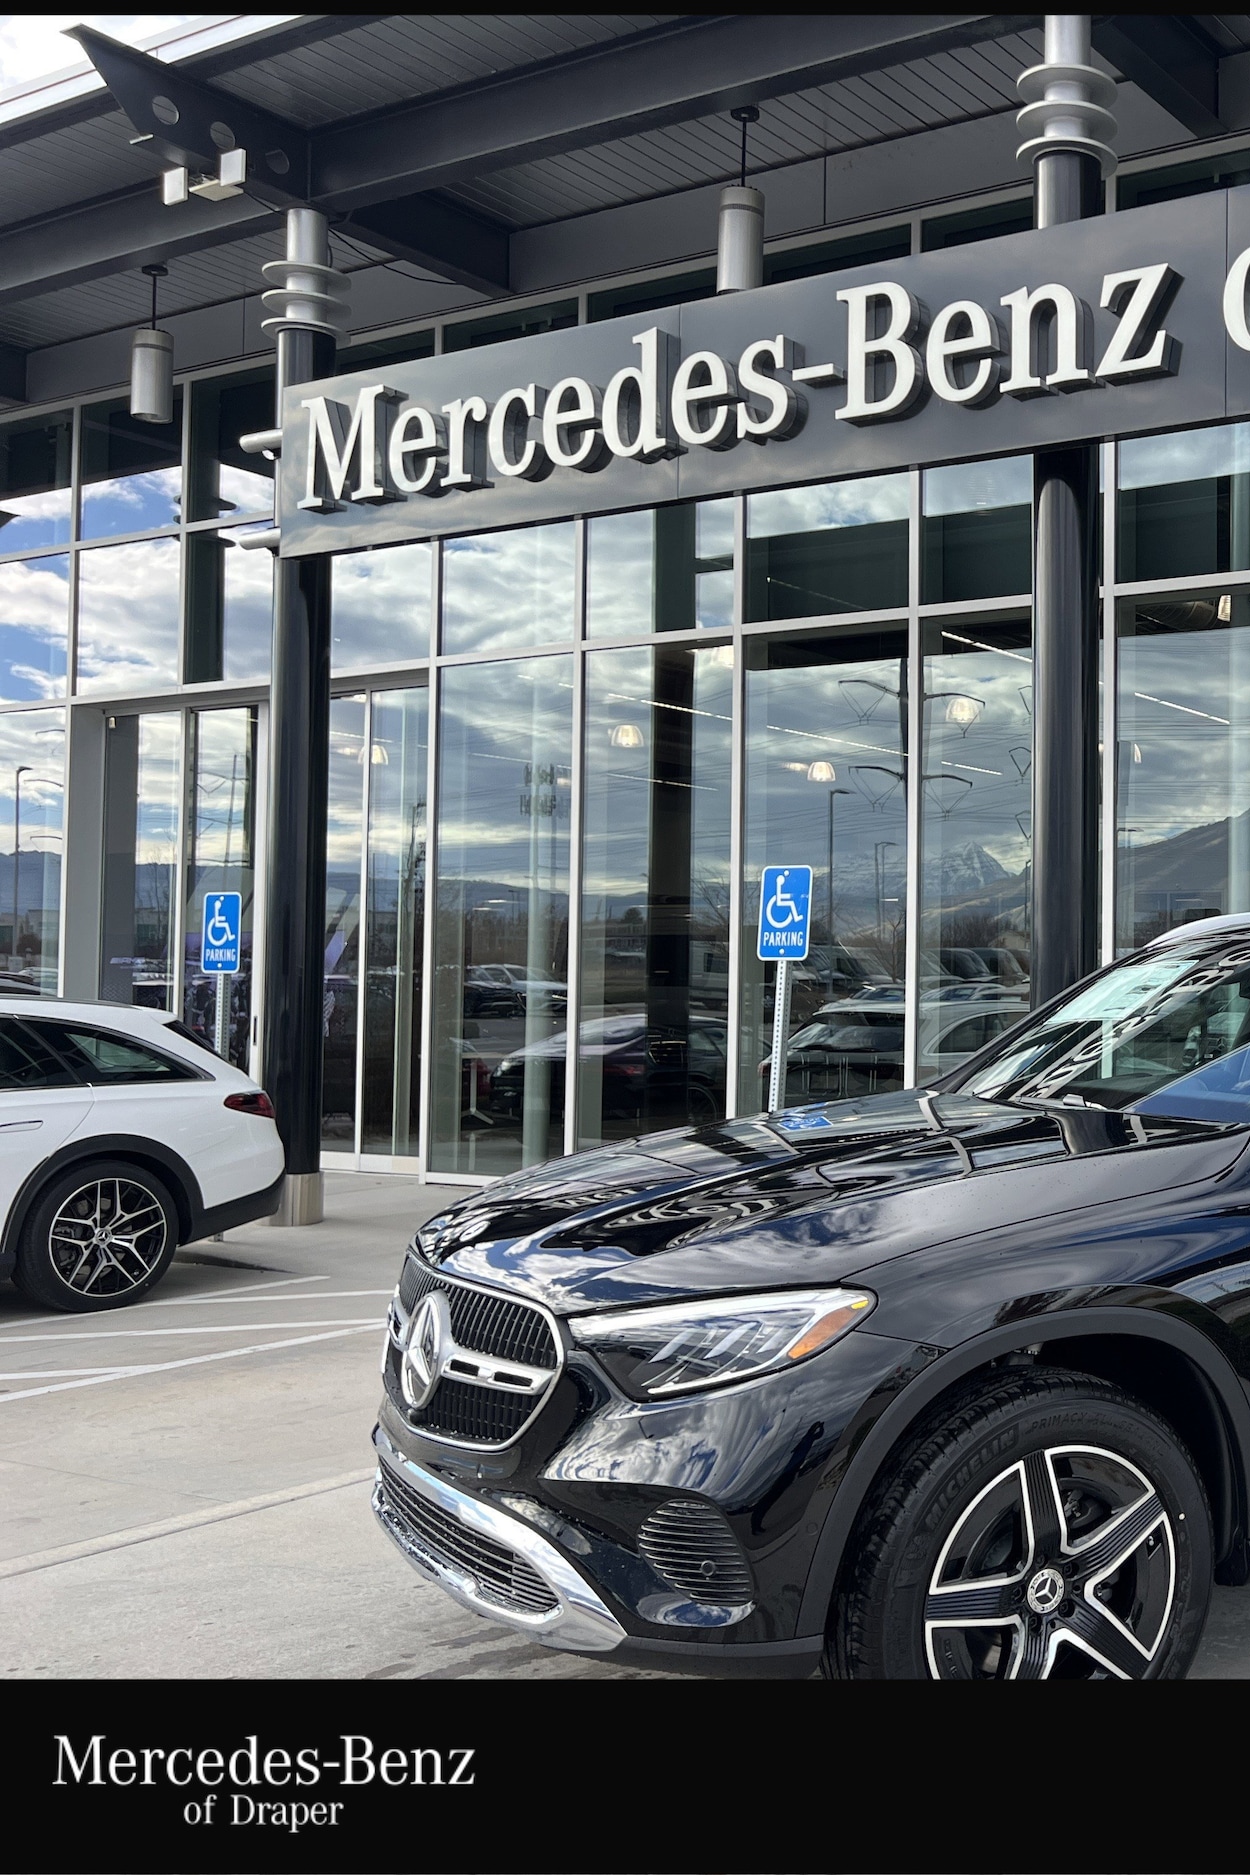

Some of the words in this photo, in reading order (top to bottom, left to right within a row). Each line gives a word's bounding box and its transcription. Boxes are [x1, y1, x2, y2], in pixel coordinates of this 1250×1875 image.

[297, 263, 1172, 512] Mercedes-Benz
[205, 948, 236, 962] PARKING
[763, 931, 803, 947] PARKING
[924, 1429, 1016, 1530] MICHELIN
